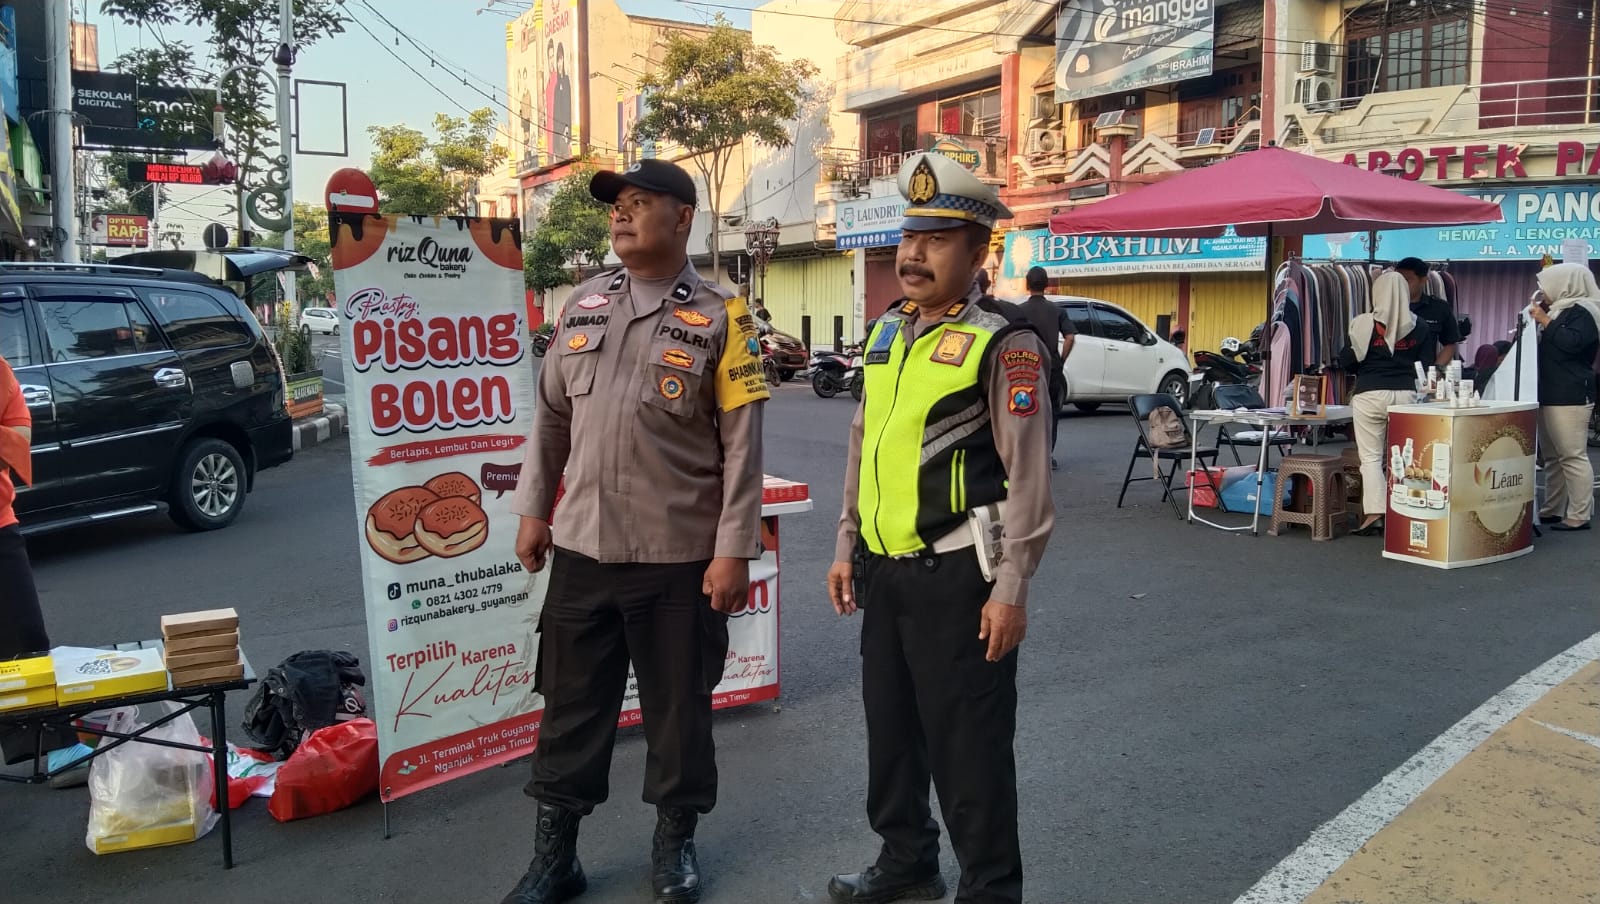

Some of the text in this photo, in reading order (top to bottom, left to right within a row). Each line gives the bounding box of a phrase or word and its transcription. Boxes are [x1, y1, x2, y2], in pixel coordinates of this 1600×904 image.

[545, 10, 569, 38] CAESAR
[1121, 0, 1208, 29] mangga
[1170, 55, 1209, 72] IBRAHIM
[77, 89, 132, 101] SEKOLAH
[78, 99, 122, 108] DIGITAL.
[108, 225, 144, 238] RAPI
[1438, 229, 1499, 241] HEMAT
[1037, 236, 1201, 262] IBRAHIM
[1479, 245, 1501, 255] JL.
[1506, 245, 1521, 255] A.
[439, 262, 466, 273] bakery
[566, 315, 609, 329] JUMADI
[659, 326, 708, 350] POLRI
[1004, 351, 1039, 362] POLRES
[390, 437, 515, 459] Berlapis, Lembut Dan Legit
[486, 466, 520, 481] Premiu
[1490, 470, 1524, 489] Léane
[406, 562, 522, 594] muna_thubalaka
[426, 583, 503, 607] 0821 4302 4779
[400, 592, 529, 627] rizqunabakery_guyangan
[386, 640, 517, 673] Terpilih Karena
[737, 654, 766, 664] Karena
[394, 660, 536, 732] Kualitas
[730, 693, 751, 702] Timur
[419, 721, 541, 765] Jl. Terminal Truk Guyanga
[434, 755, 474, 774] Nganjuk
[482, 745, 507, 758] Jawa
[509, 735, 535, 749] Timur
